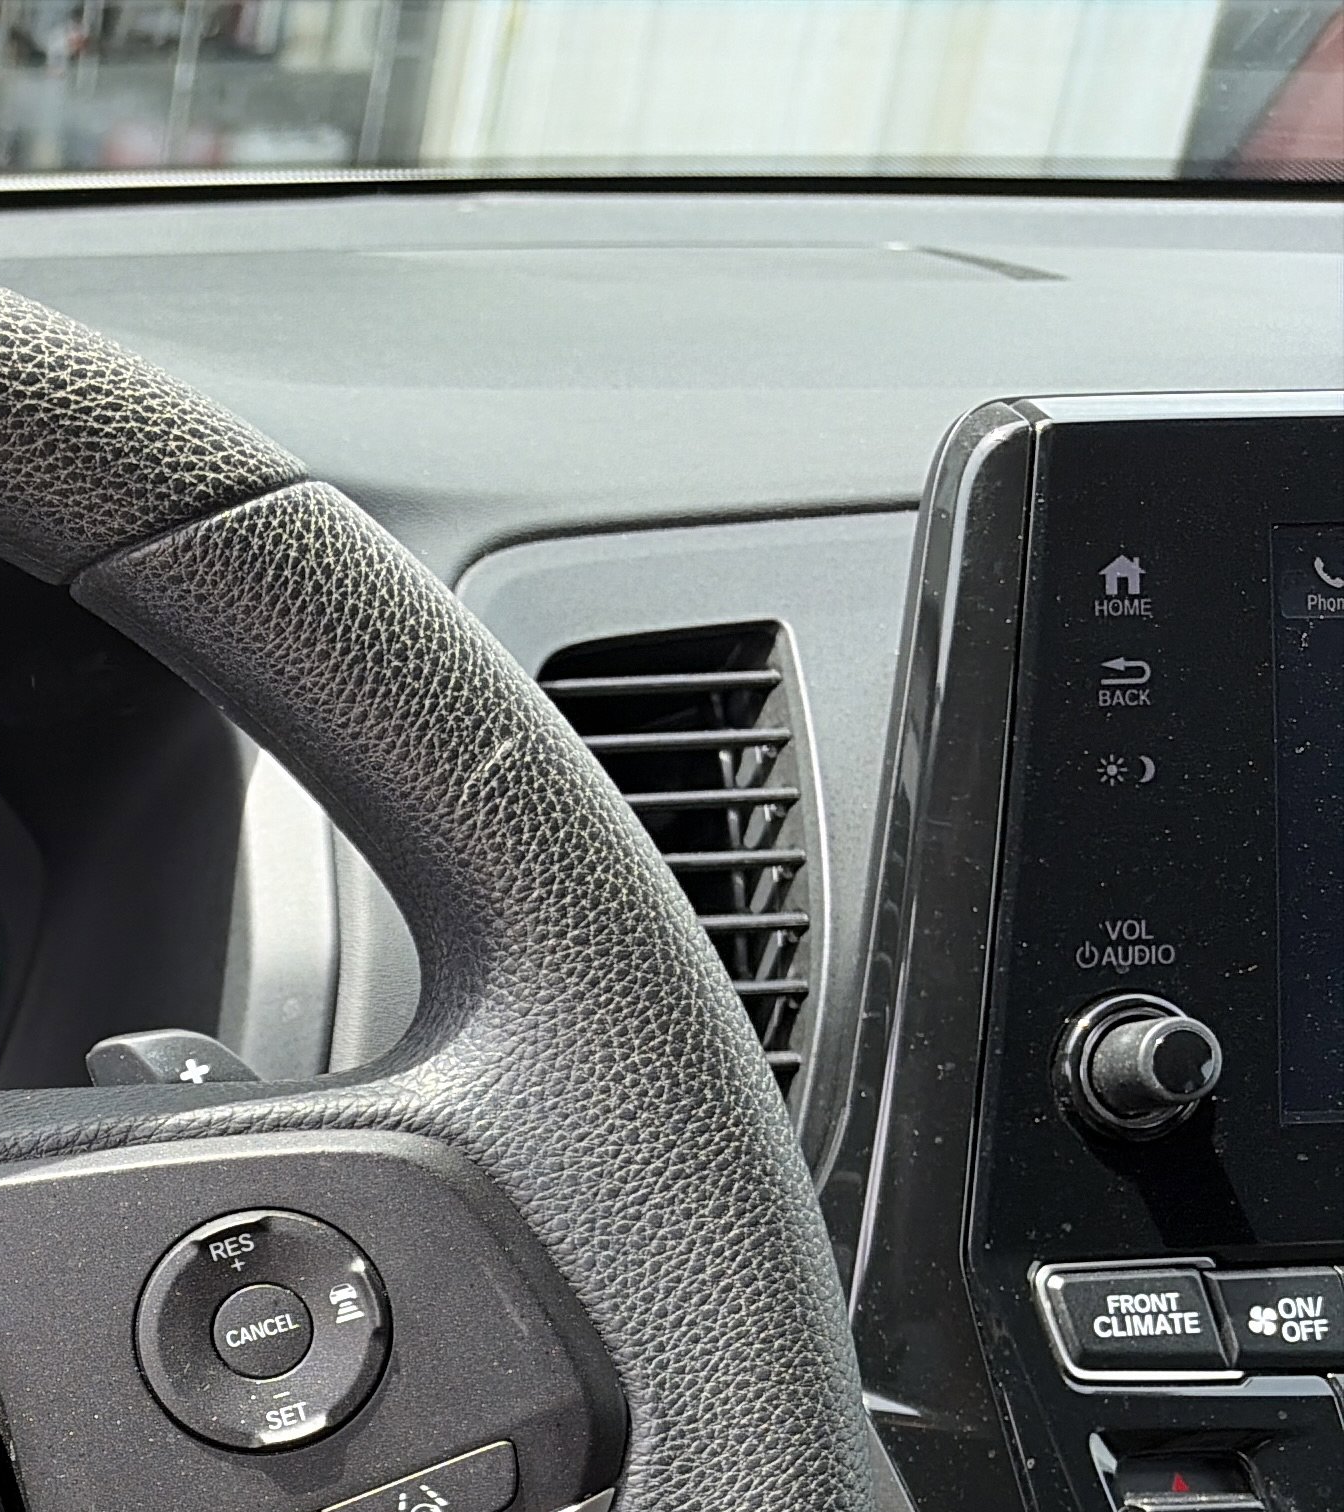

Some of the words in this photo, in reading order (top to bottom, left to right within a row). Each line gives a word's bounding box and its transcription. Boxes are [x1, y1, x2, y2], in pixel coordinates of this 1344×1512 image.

[1094, 599, 1152, 617] HOME
[1098, 687, 1151, 707] BACK
[1105, 920, 1154, 940] VOL
[1101, 944, 1175, 967] AUDIO
[208, 1232, 255, 1262] RES
[1106, 1292, 1180, 1315] FRONT
[1278, 1296, 1323, 1319] ON/
[225, 1313, 300, 1348] CANCEL
[1093, 1313, 1202, 1338] CLIMATE
[1281, 1318, 1329, 1343] OFF
[265, 1403, 307, 1430] SET
